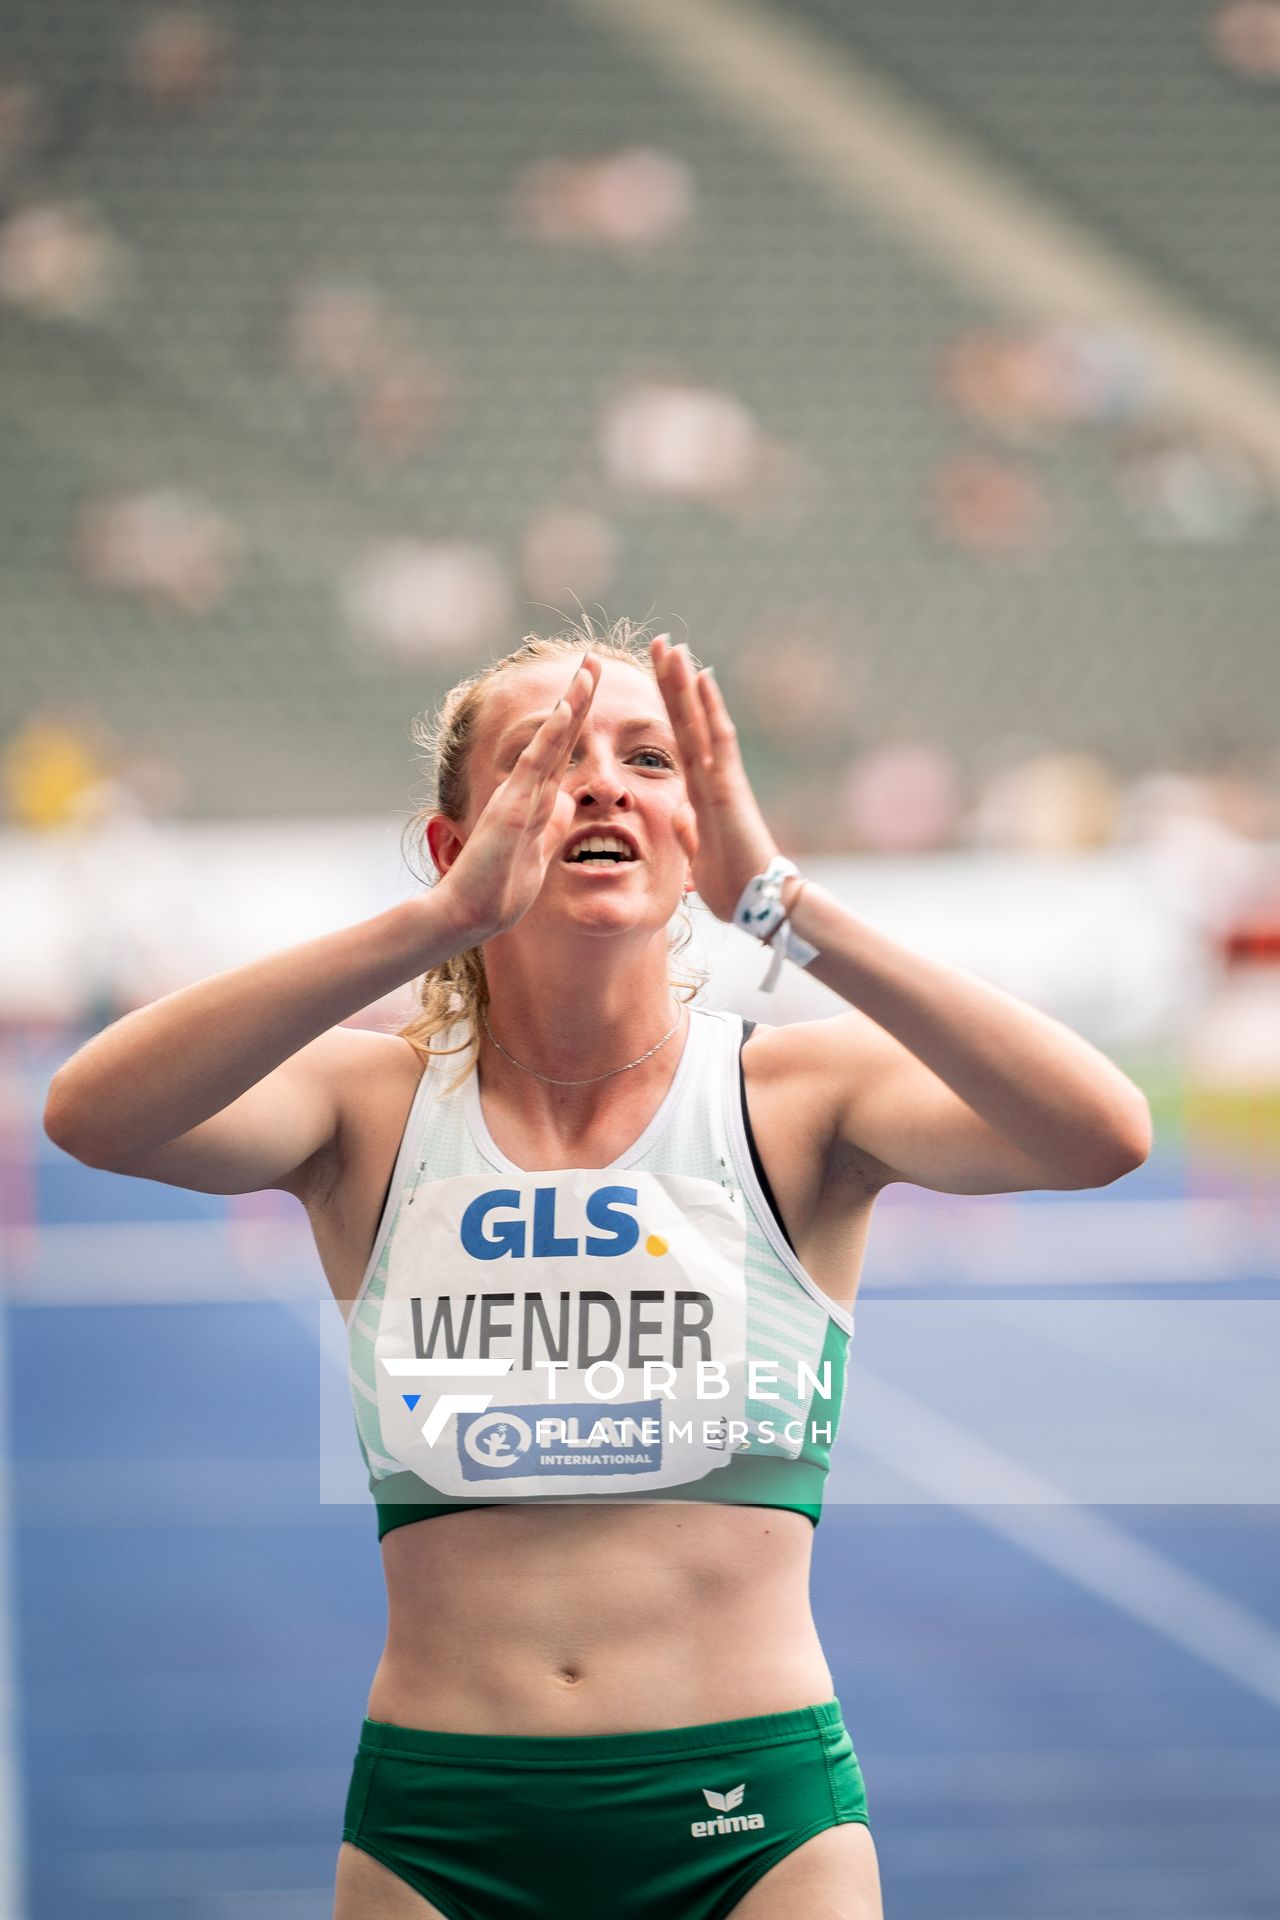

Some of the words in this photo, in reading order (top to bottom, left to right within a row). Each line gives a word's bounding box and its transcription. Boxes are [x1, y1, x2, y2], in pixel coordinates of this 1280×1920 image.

[410, 1290, 714, 1371] WENDER
[540, 1417, 653, 1448] PLAN
[540, 1453, 653, 1465] INTERNATIONAL
[691, 1813, 765, 1838] erima
